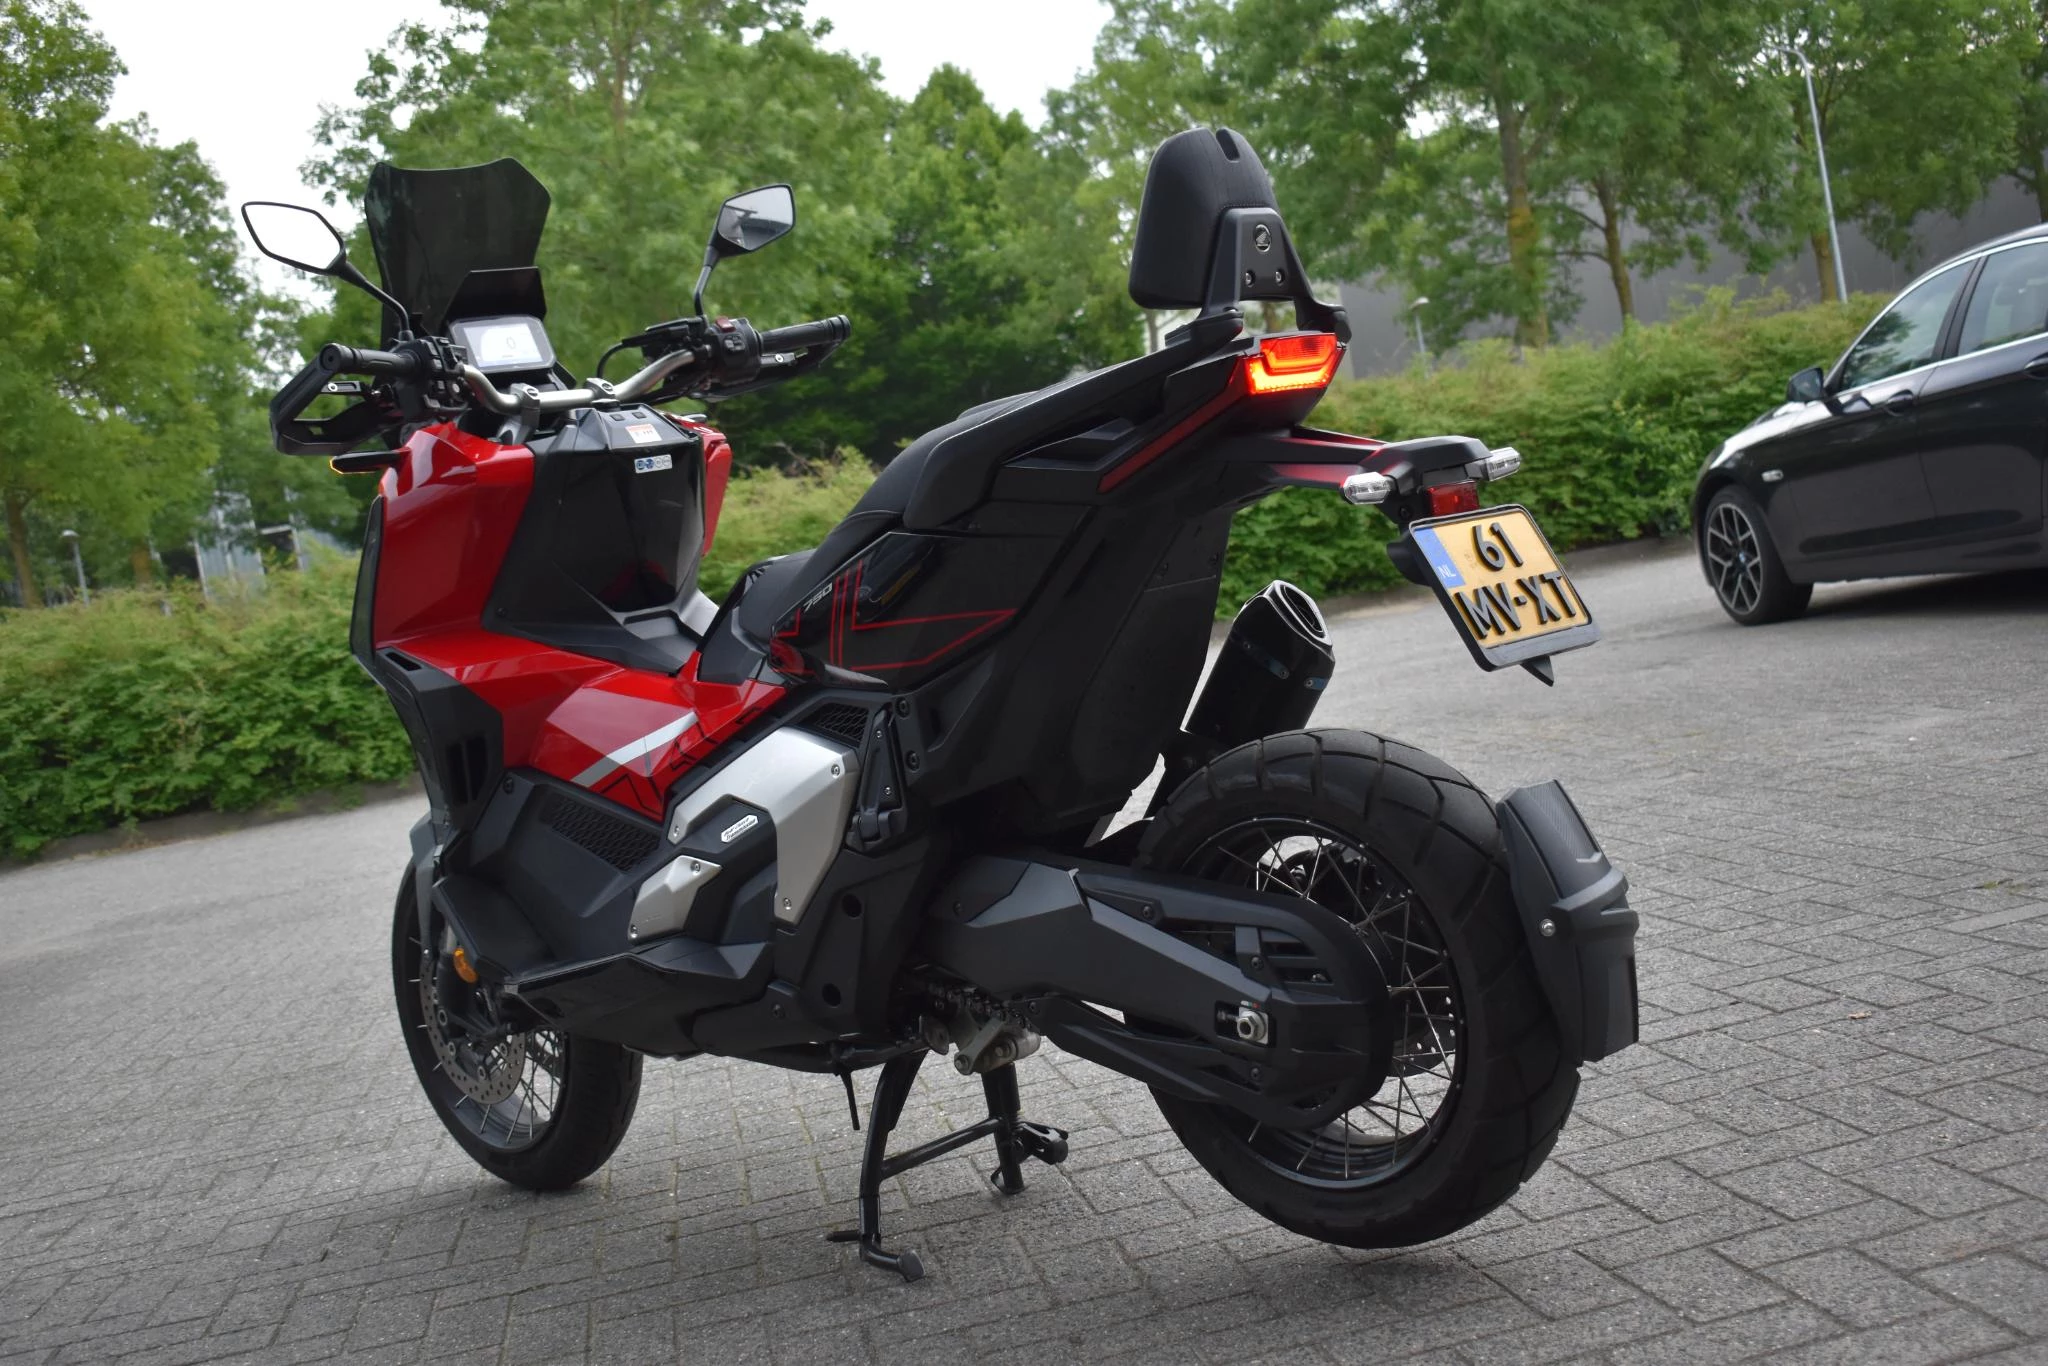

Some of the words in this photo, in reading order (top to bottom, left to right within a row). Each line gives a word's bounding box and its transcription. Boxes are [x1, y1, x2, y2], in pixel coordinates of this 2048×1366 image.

[1472, 522, 1524, 571] 61
[1436, 564, 1457, 579] NL
[803, 582, 833, 613] 750
[1454, 571, 1576, 640] MV-XT
